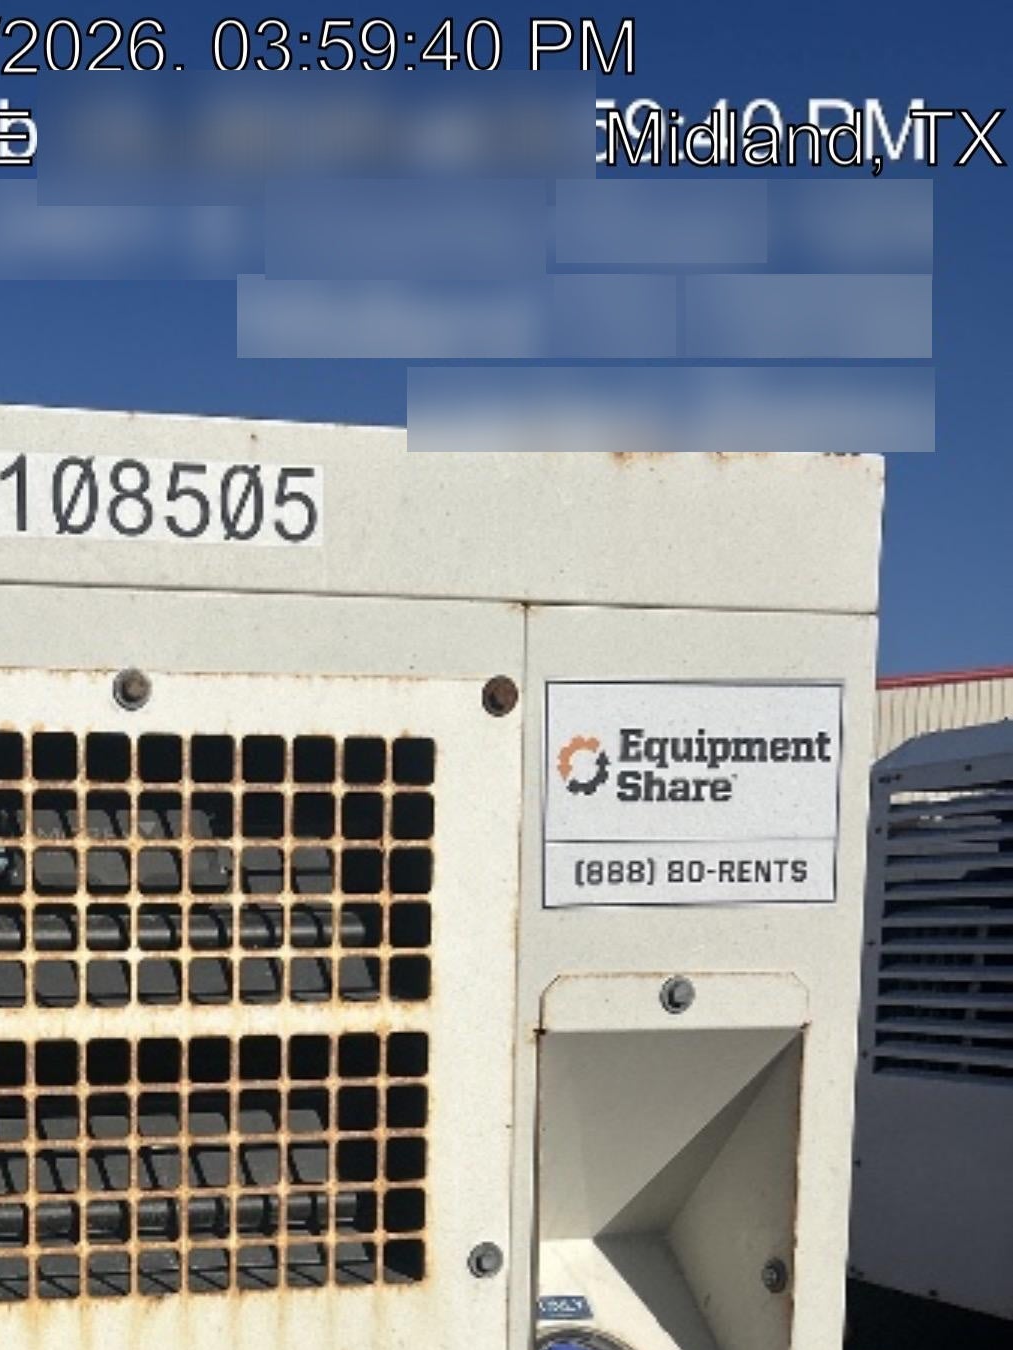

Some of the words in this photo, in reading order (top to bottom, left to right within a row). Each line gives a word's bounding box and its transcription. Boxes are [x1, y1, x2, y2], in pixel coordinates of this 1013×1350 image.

[617, 727, 832, 769] Equipment
[615, 770, 733, 803] Share
[574, 857, 656, 886] (888)
[666, 858, 809, 884] 80-RENTS
